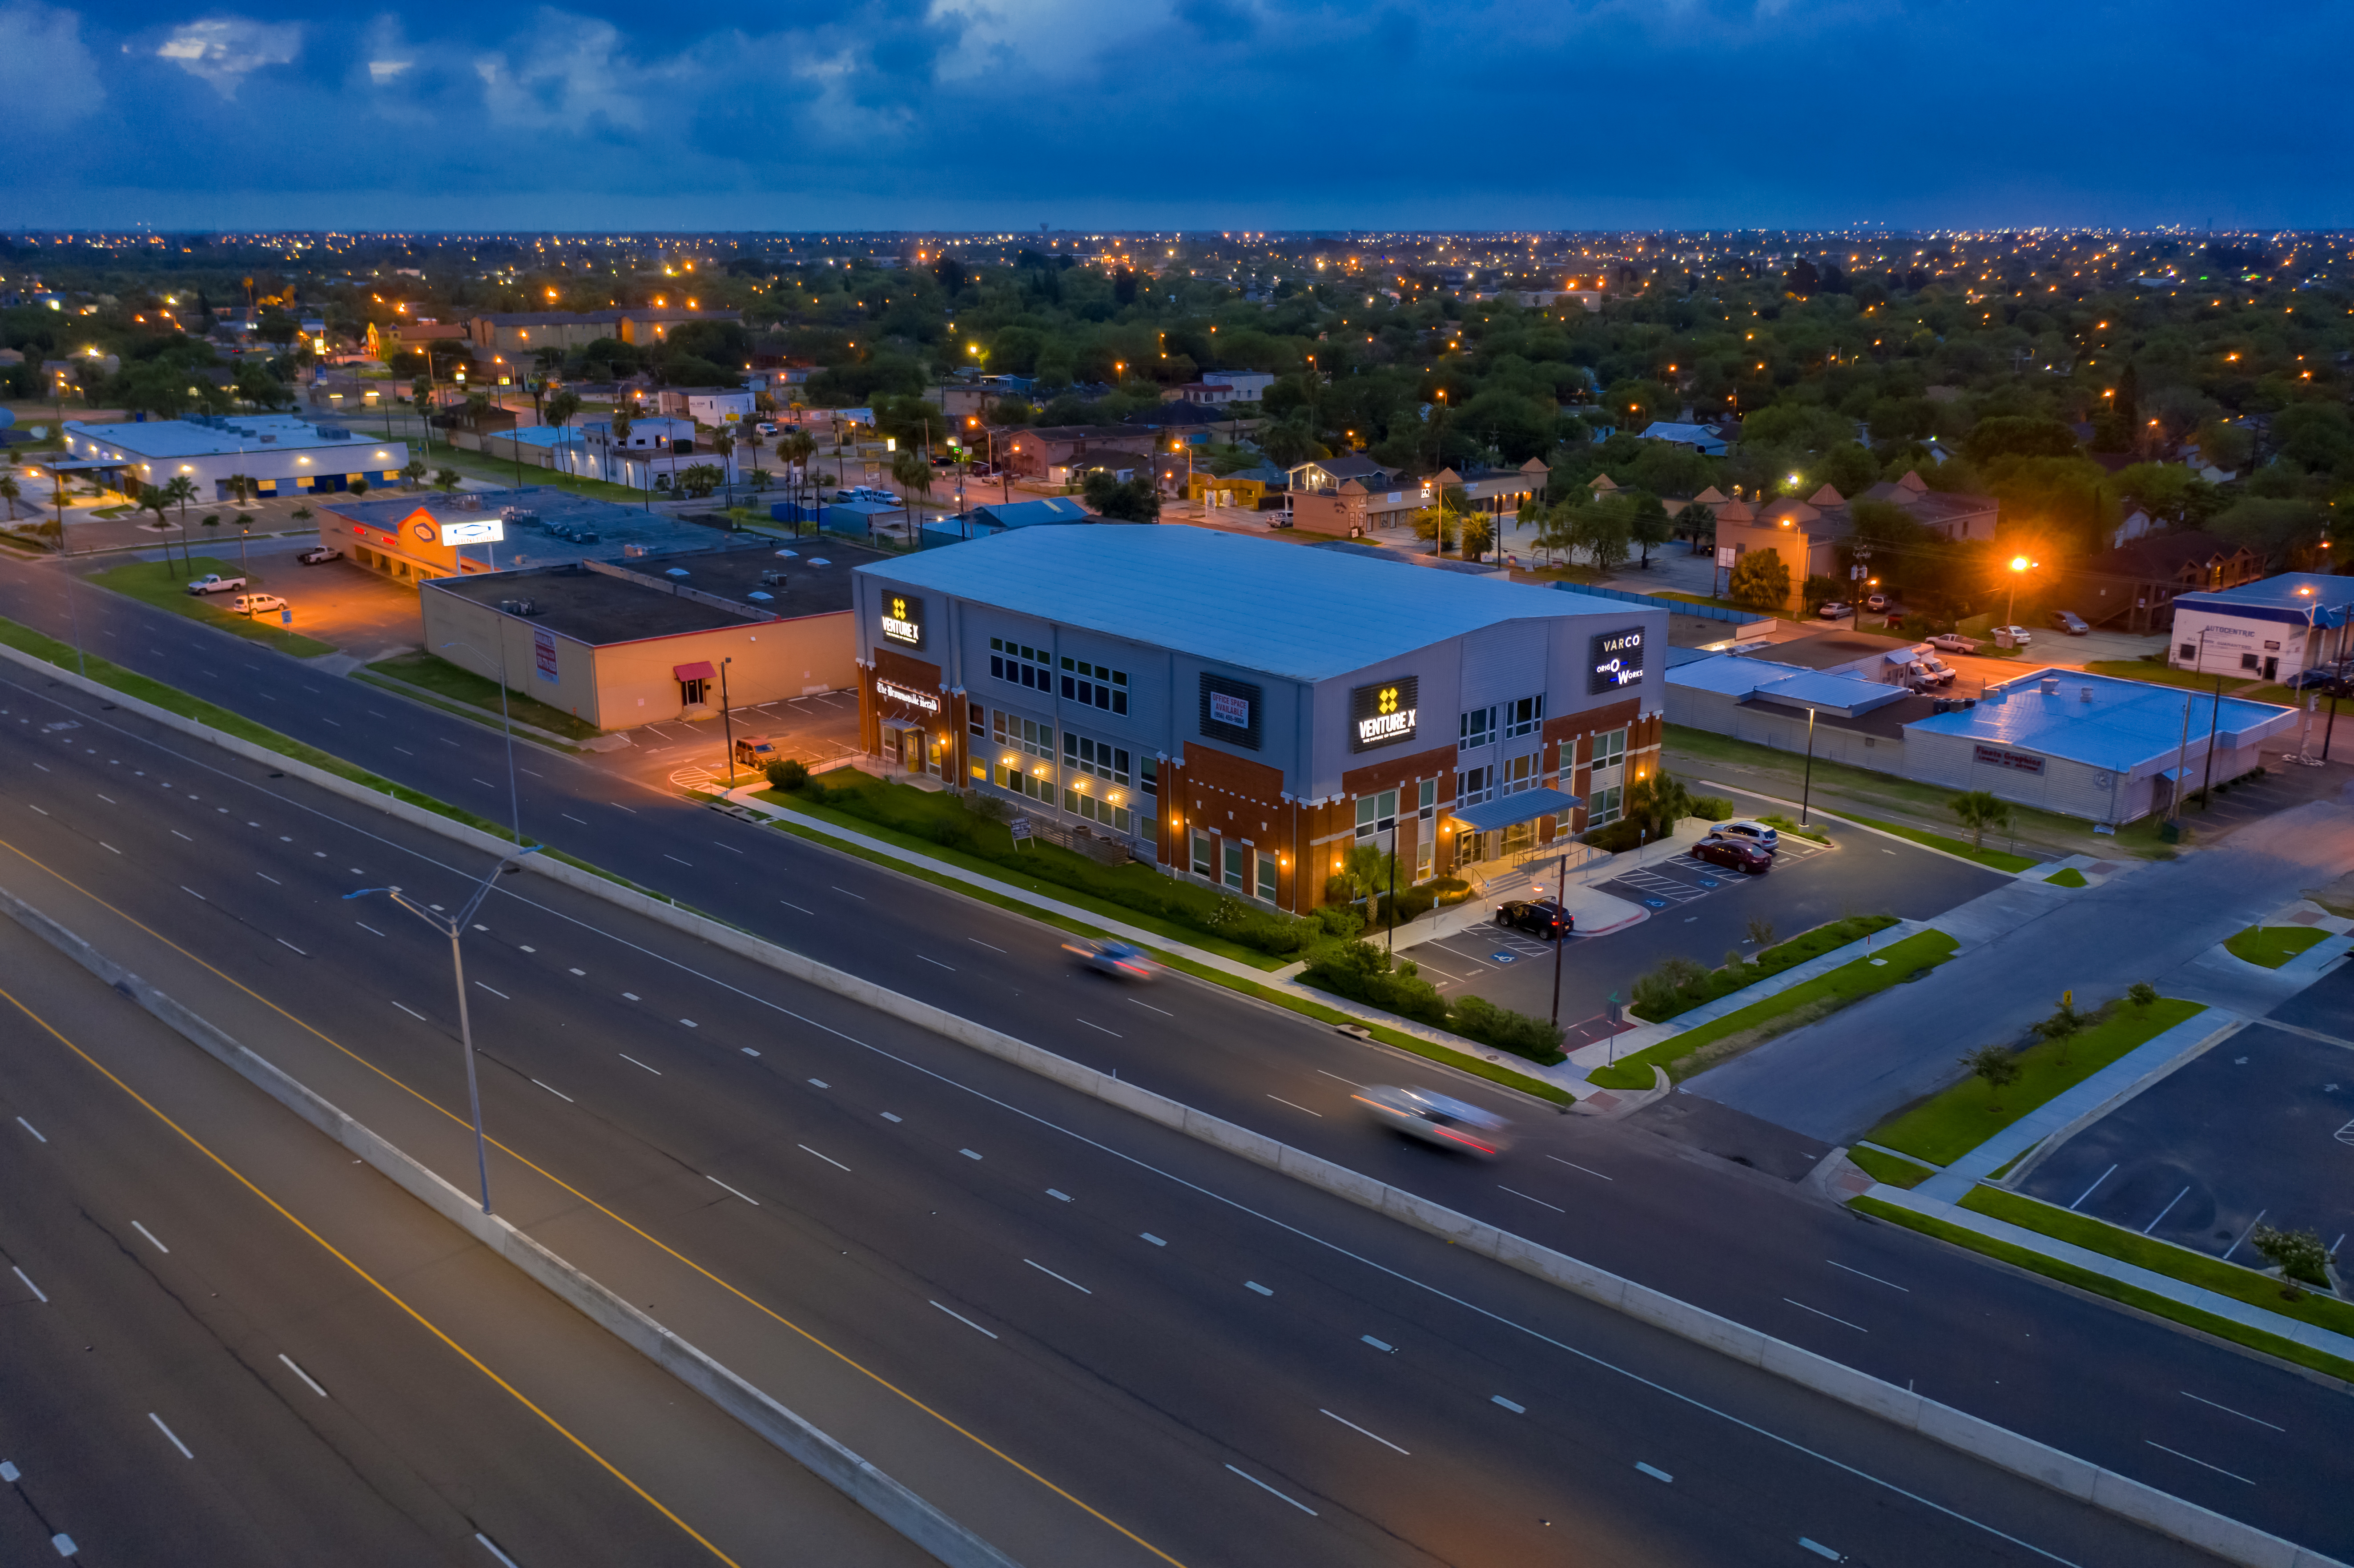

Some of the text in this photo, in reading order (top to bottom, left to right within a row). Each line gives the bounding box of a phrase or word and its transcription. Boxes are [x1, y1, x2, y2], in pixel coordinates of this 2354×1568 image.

[882, 616, 913, 638] VENTURE
[913, 625, 919, 640] X
[2205, 625, 2255, 638] AUTOCENTRIC
[1603, 635, 1640, 652] VARCO
[1596, 659, 1621, 673] ORIGO
[1618, 670, 1643, 685] WORKS
[877, 682, 937, 711] The Brownsville Herald
[1213, 693, 1247, 709] OFFICE SPACE
[1214, 711, 1224, 720] (956)
[1215, 703, 1243, 717] AVAILABLE
[1359, 709, 1416, 739] VENTURE X
[1976, 746, 2042, 767] Fiesta Graphics
